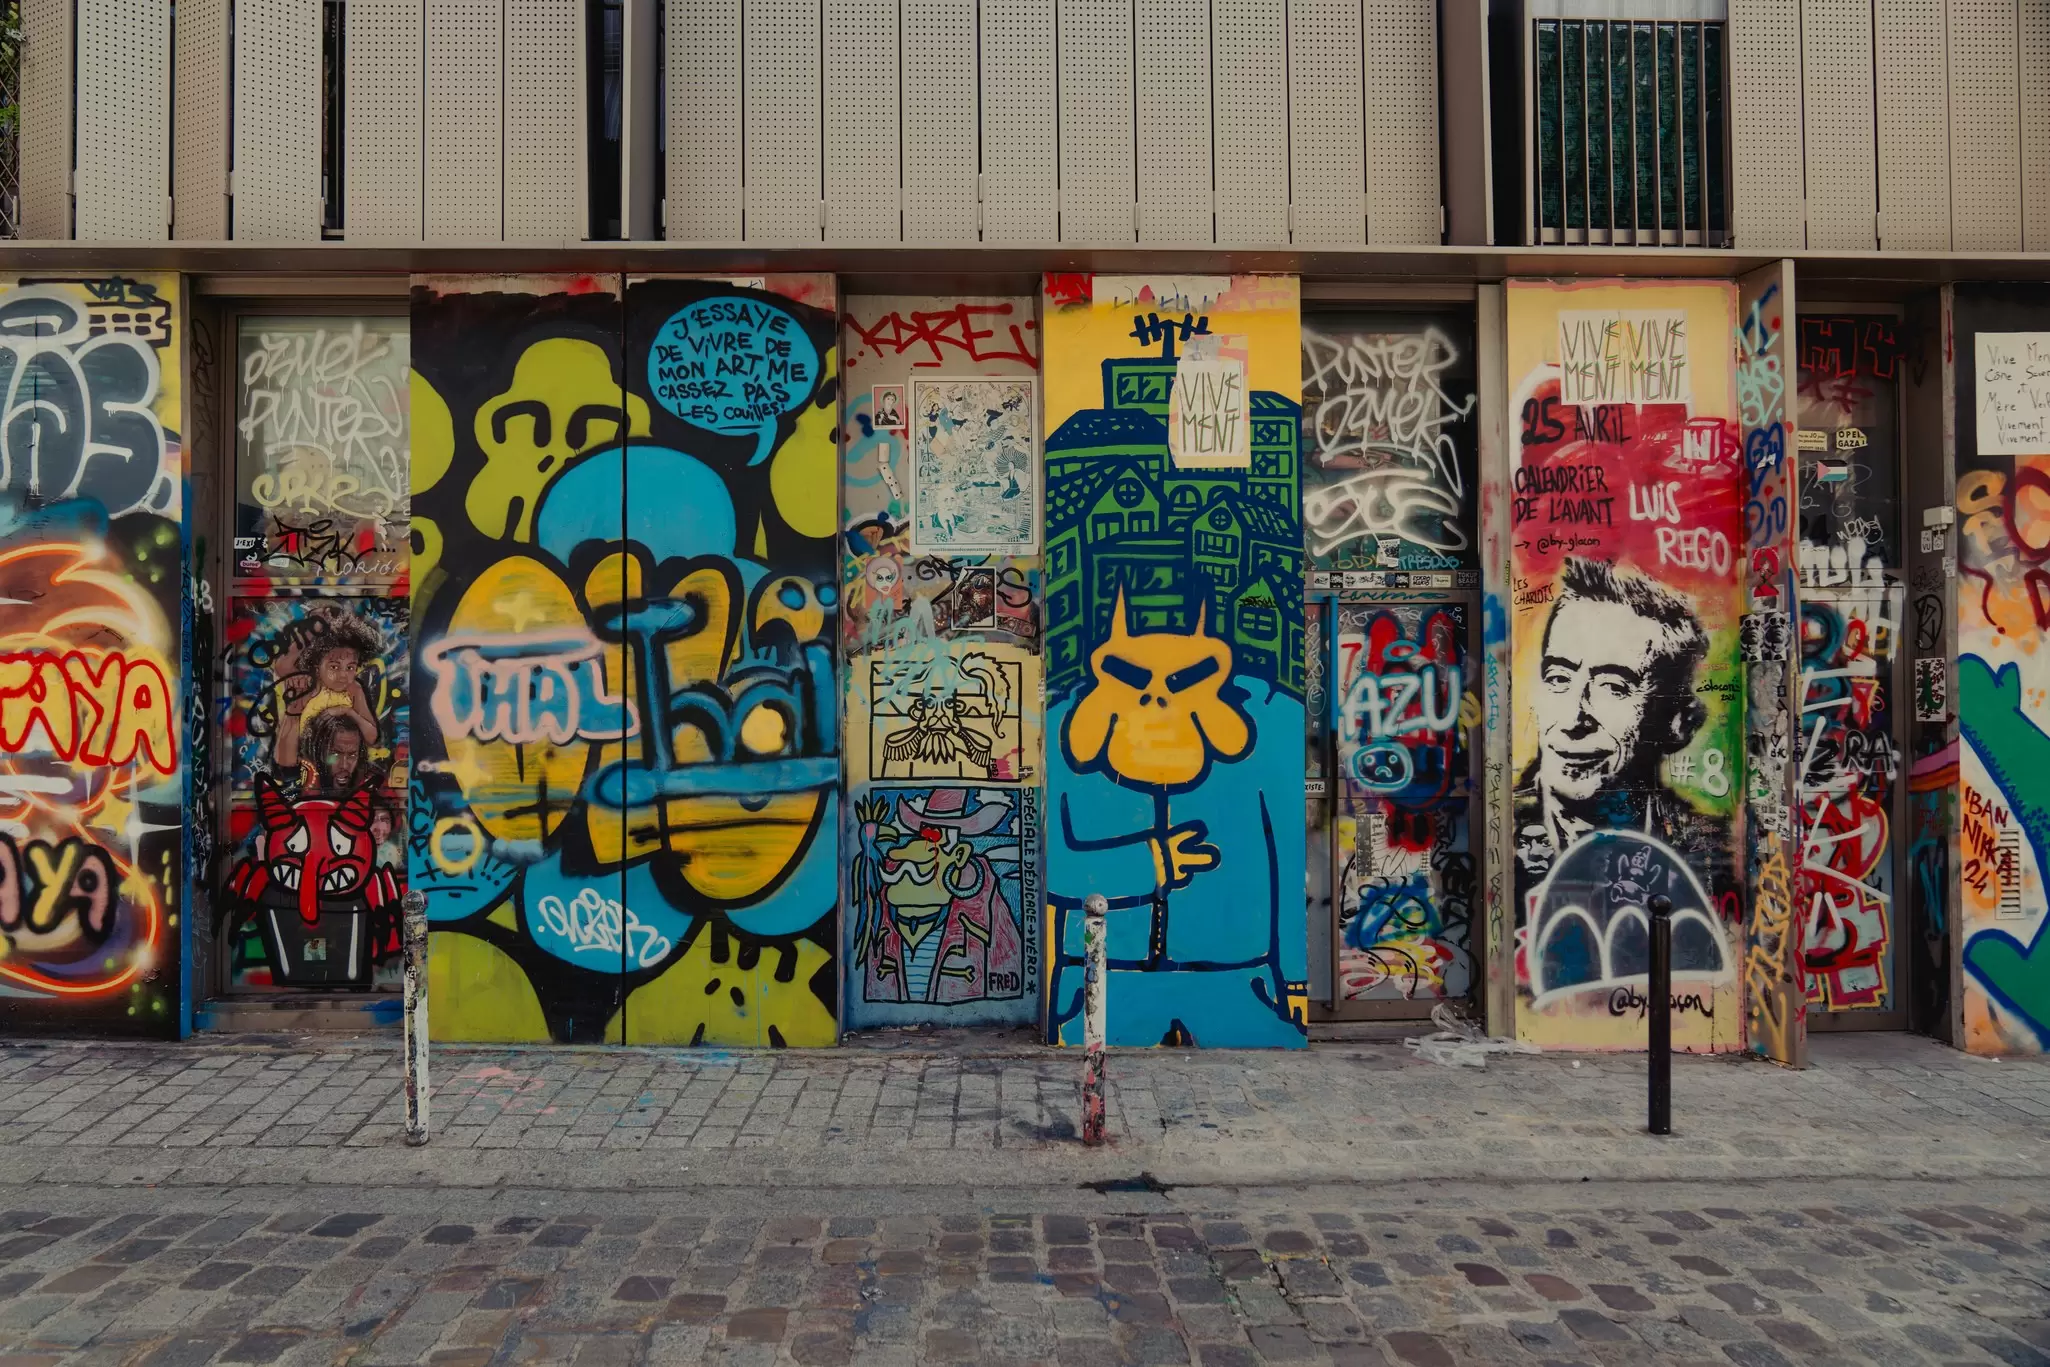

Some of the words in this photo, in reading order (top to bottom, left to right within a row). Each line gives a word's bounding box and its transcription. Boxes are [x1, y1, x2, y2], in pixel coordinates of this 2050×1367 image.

[671, 303, 790, 340] J'ESSAYE
[656, 345, 683, 364] DE
[765, 337, 792, 359] DE
[1562, 319, 1619, 361] VIVE
[1627, 319, 1685, 361] VIVE
[658, 361, 706, 382] MON
[768, 359, 808, 384] ME
[658, 380, 734, 400] CASSEZ
[743, 382, 790, 403] PAS
[1181, 372, 1239, 413] VIVE
[677, 402, 719, 424] LES
[1521, 396, 1566, 445] 25
[1515, 497, 1537, 525] DE
[1550, 498, 1614, 528] L'AVANT
[1656, 527, 1732, 577] REGO
[1513, 578, 1528, 592] LES
[1340, 668, 1463, 740] AZU
[1669, 748, 1731, 797] #8
[1964, 858, 1989, 894] 24
[988, 972, 1020, 991] FRED
